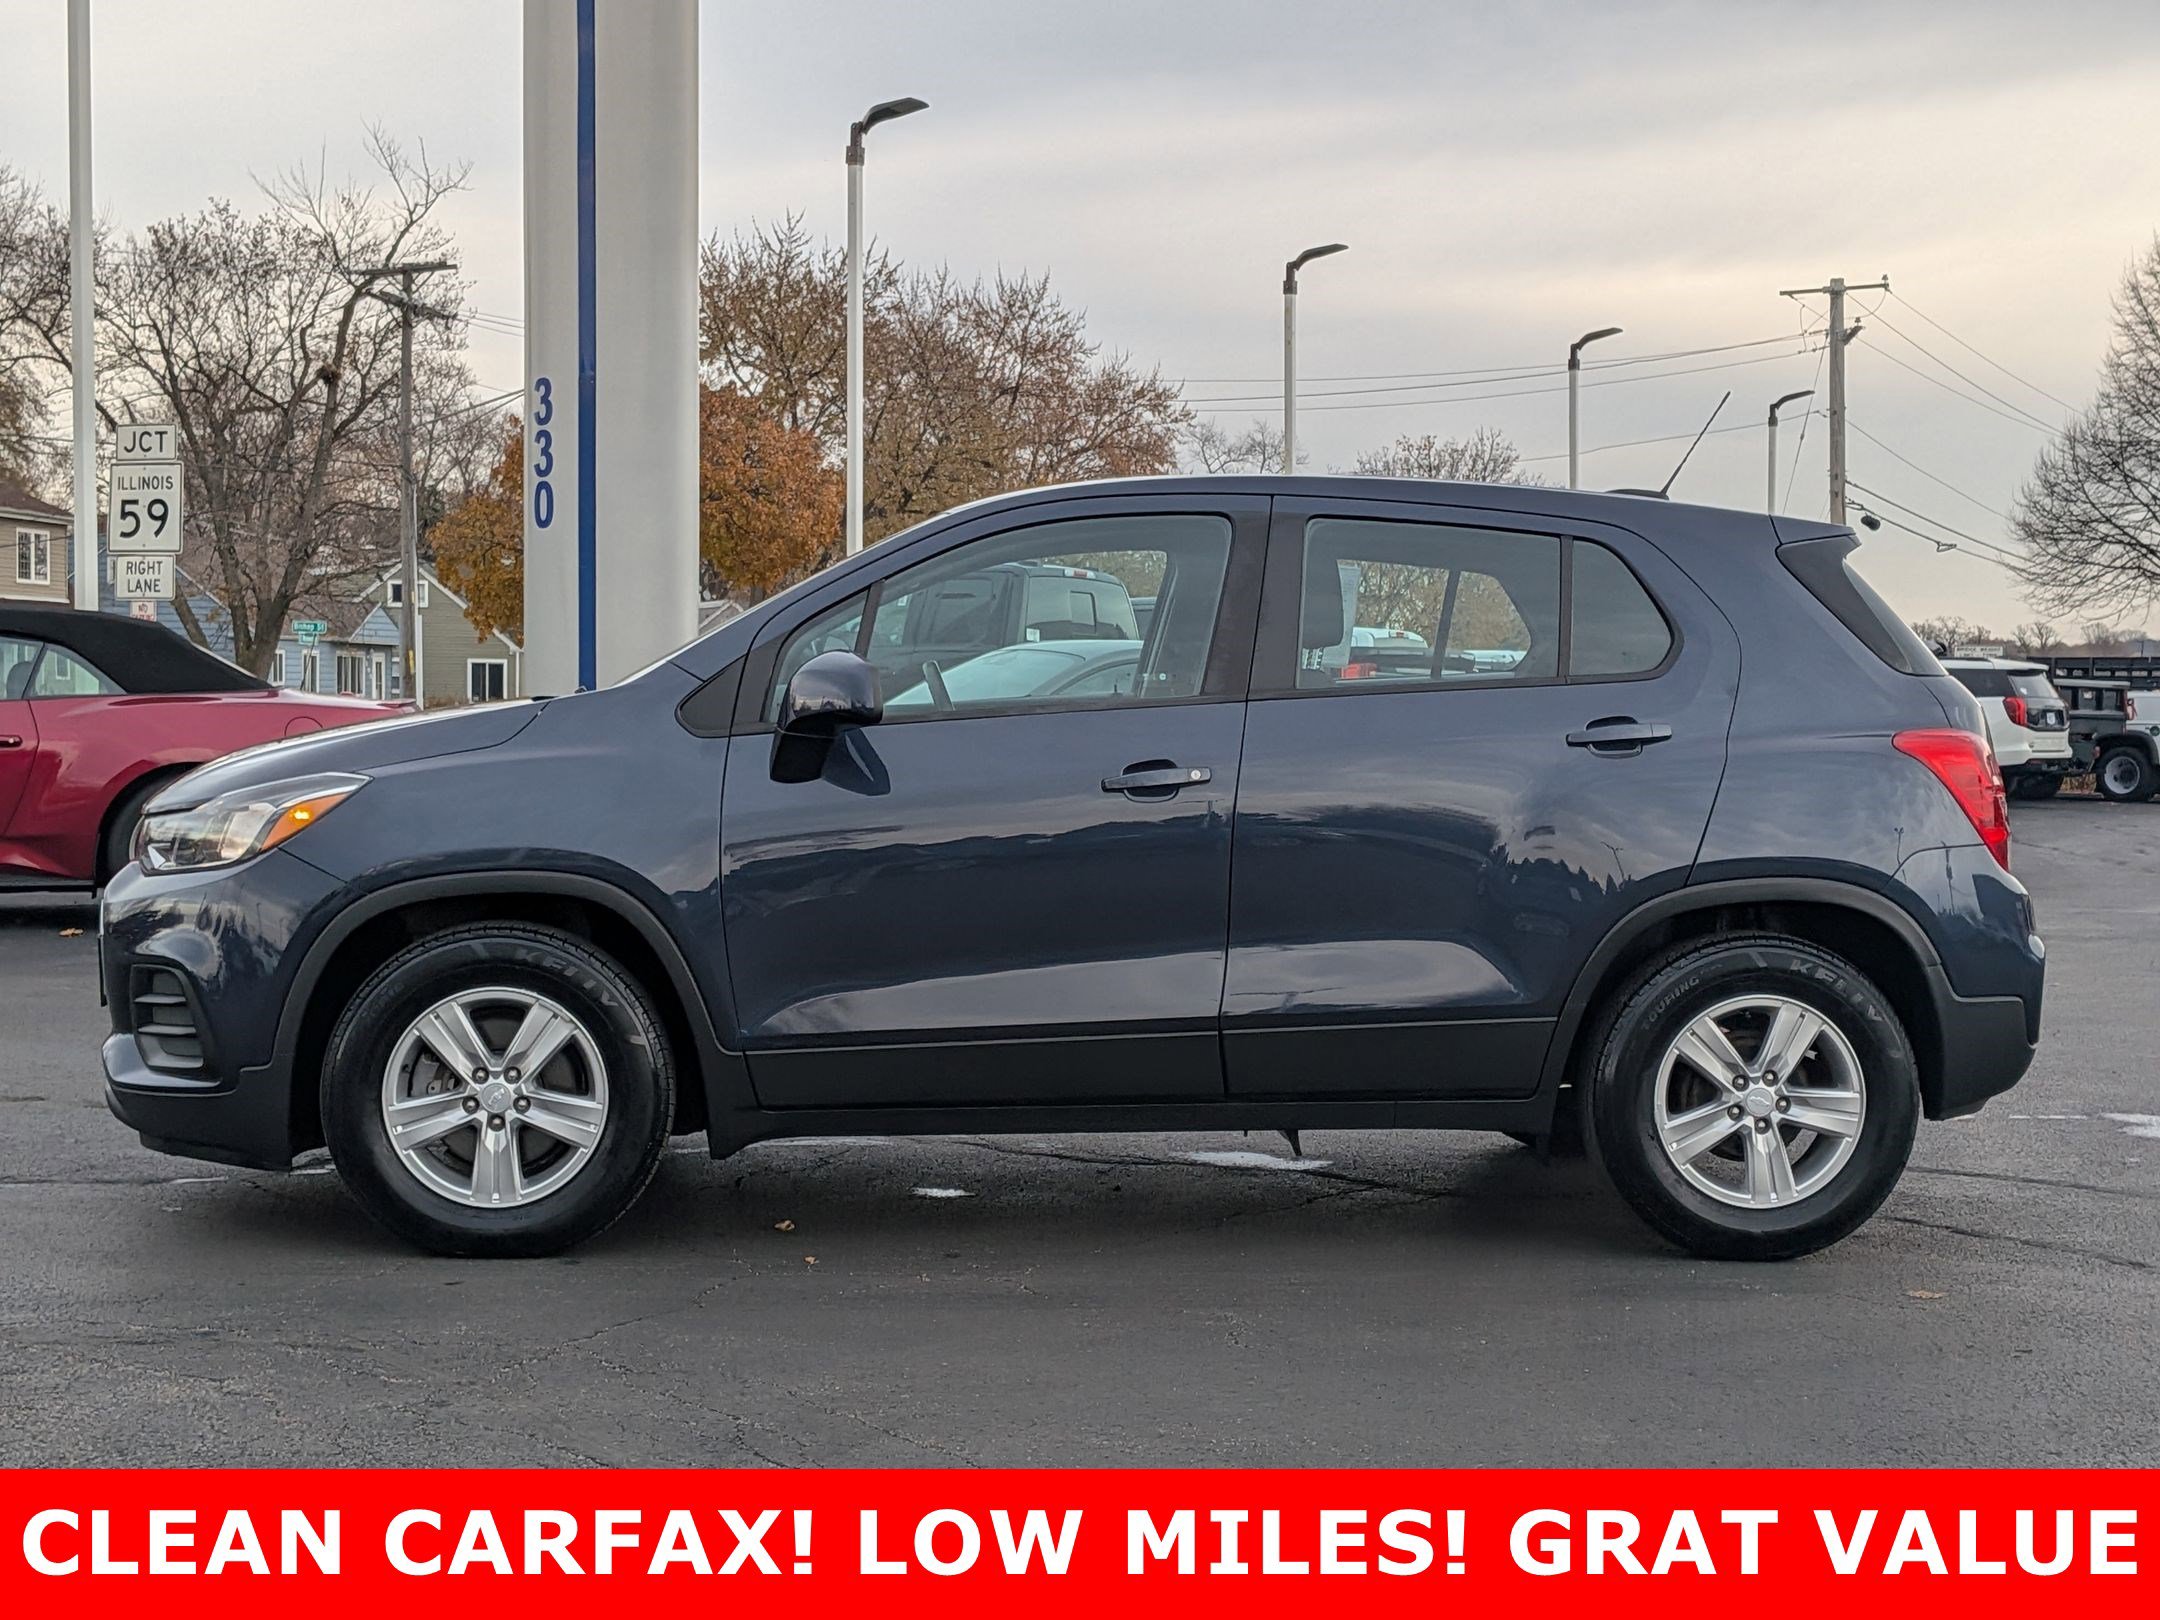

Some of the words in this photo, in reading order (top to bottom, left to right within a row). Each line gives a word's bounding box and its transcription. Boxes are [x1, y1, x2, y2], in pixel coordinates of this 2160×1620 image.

[123, 431, 168, 453] JCT
[533, 377, 554, 529] 330
[117, 475, 174, 491] ILLINOIS
[119, 498, 169, 538] 59
[126, 560, 163, 576] RIGHT
[127, 578, 161, 593] LANE
